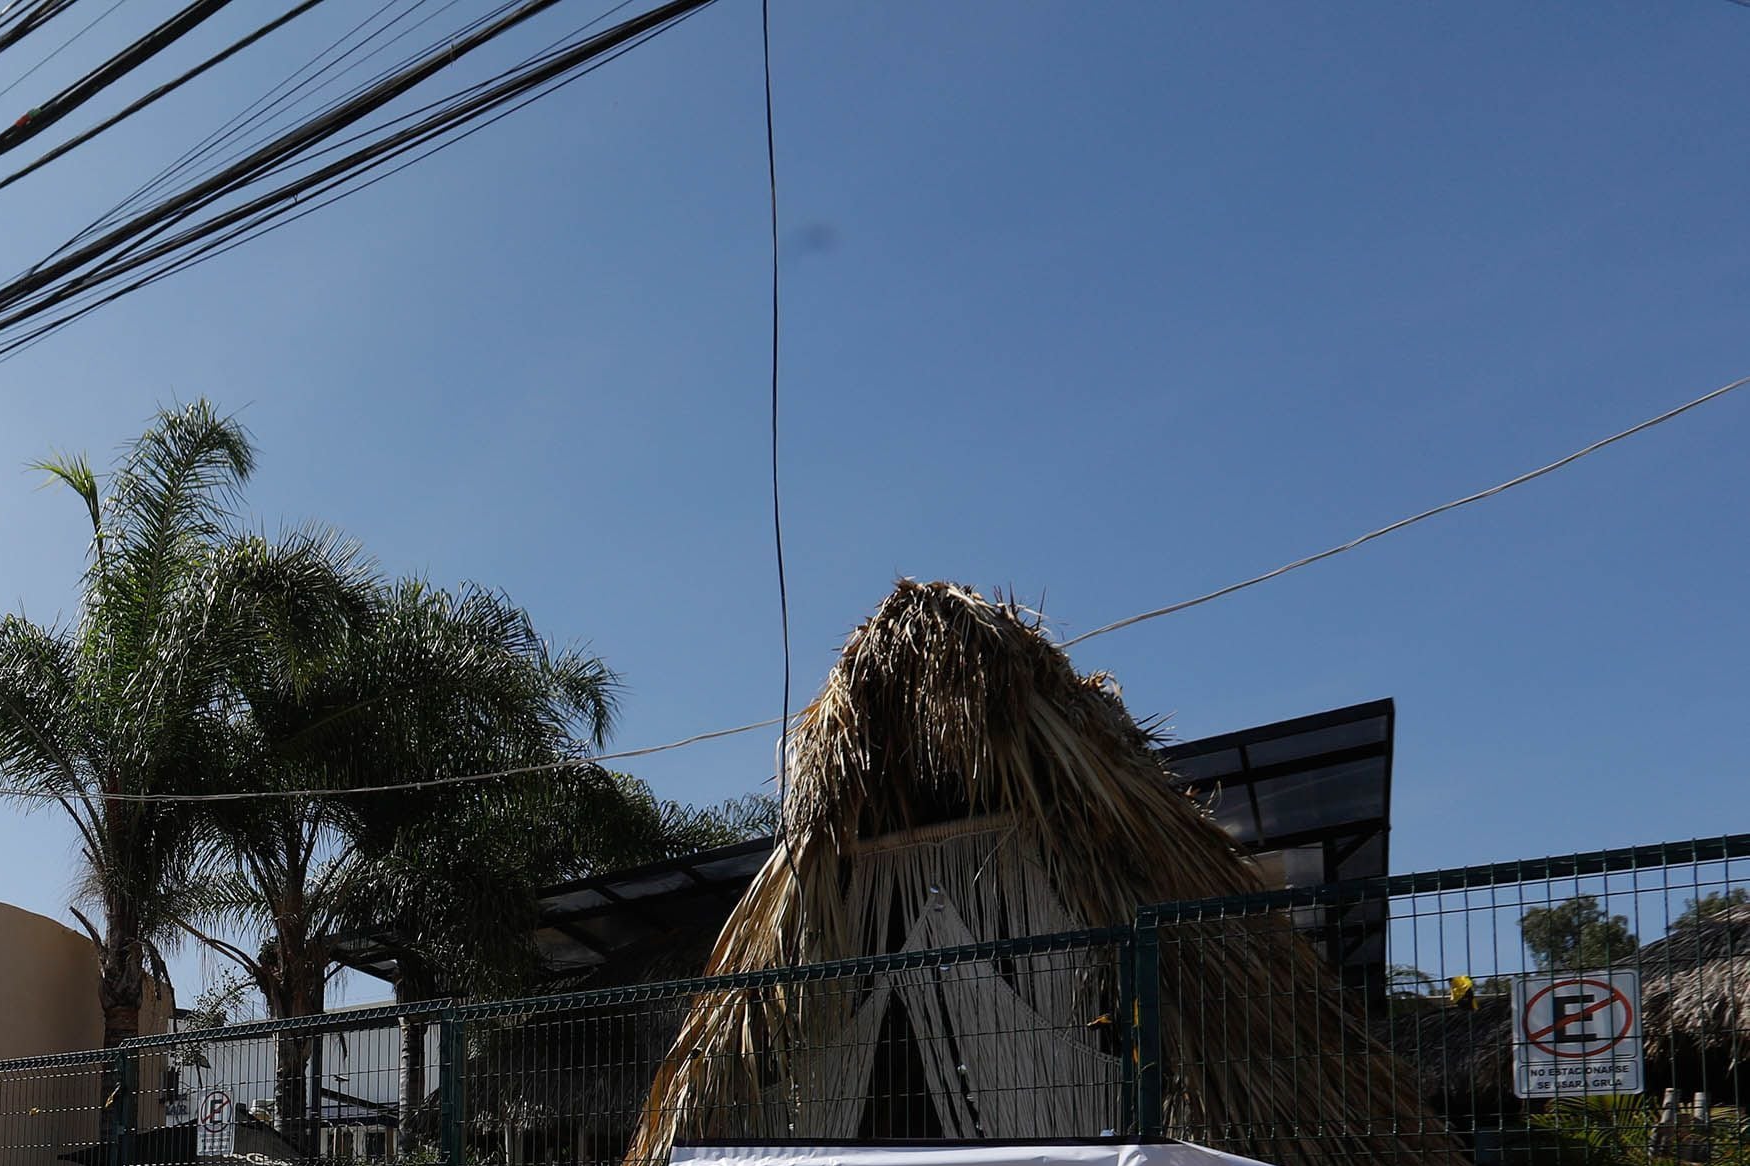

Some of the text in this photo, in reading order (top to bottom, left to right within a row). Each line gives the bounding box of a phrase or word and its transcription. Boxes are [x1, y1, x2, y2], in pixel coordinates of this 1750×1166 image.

[1530, 1065, 1630, 1077] NO ESTACONARSE
[1537, 1081, 1551, 1089] SE
